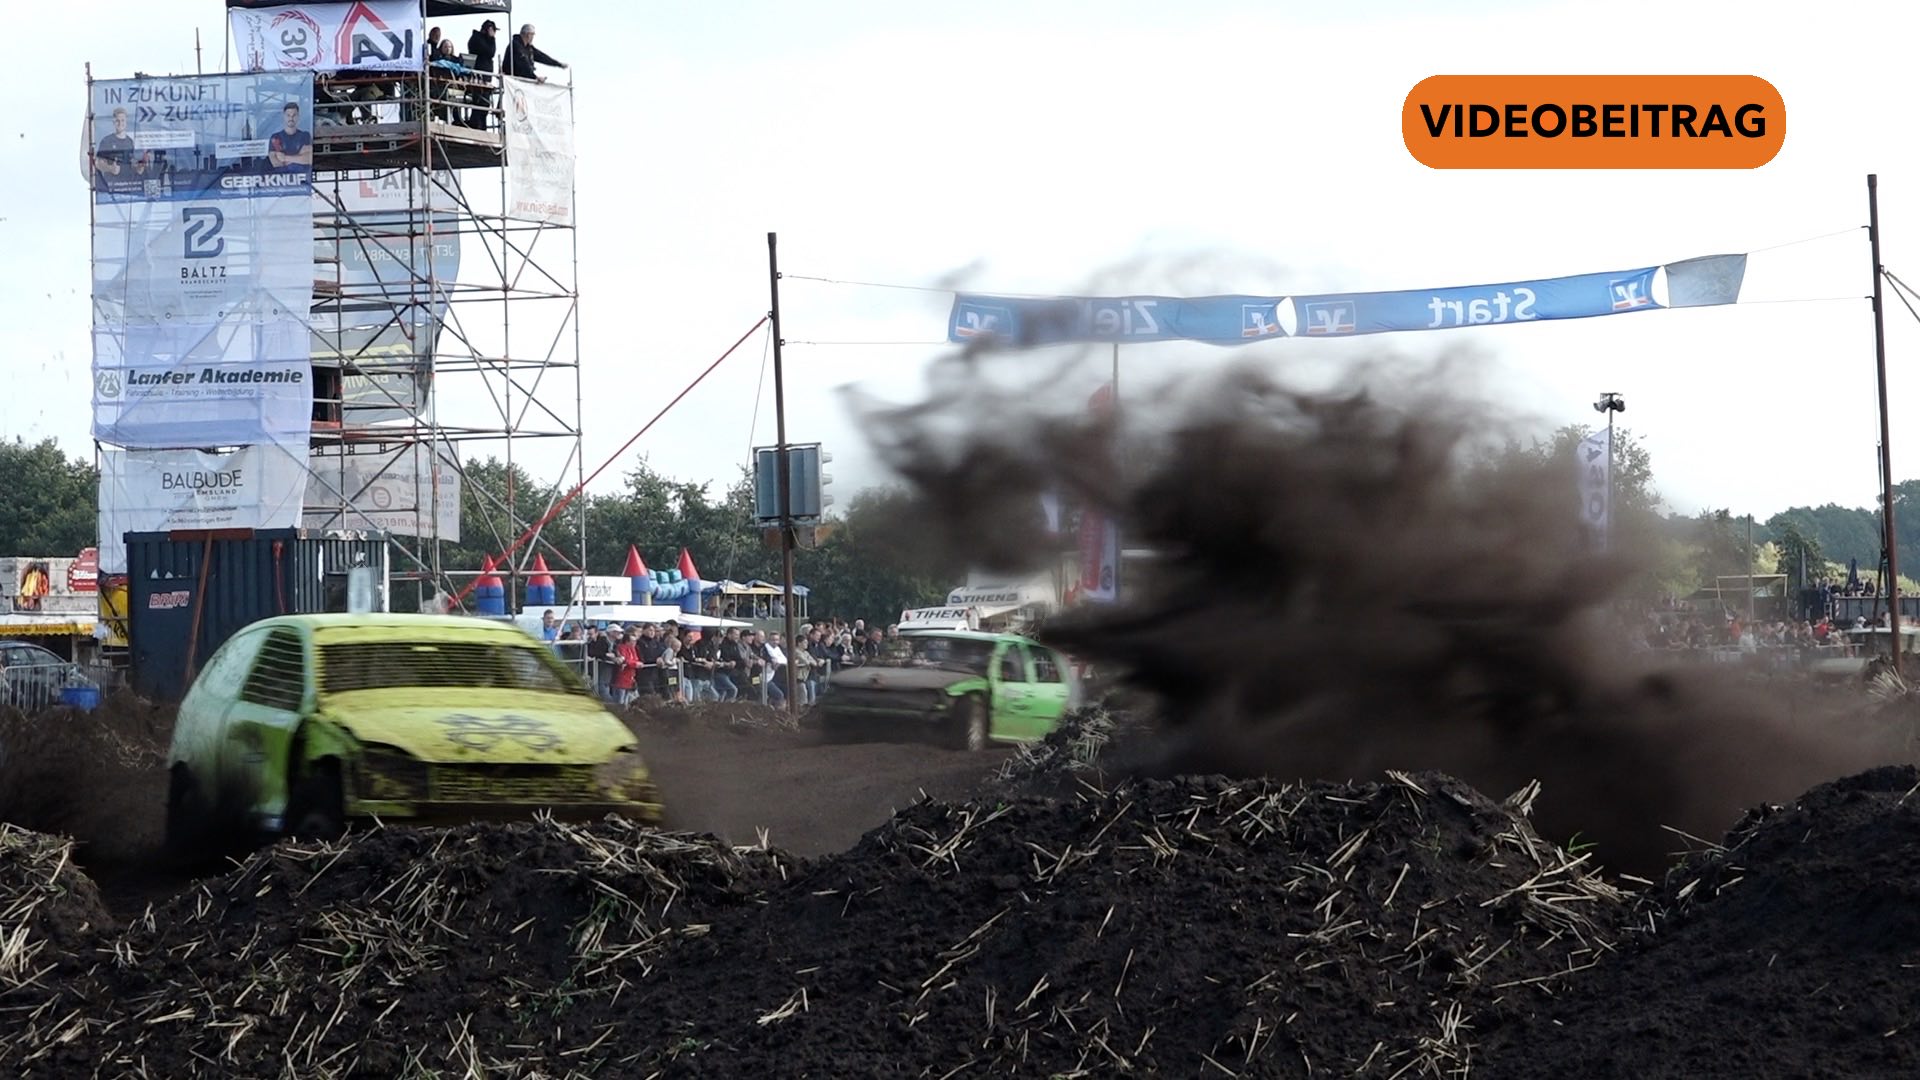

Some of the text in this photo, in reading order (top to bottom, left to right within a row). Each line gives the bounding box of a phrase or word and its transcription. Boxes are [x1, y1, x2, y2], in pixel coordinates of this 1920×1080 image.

[105, 83, 221, 104] IN ZUKUNFT
[181, 265, 227, 279] BALTZ
[127, 367, 303, 385] Lanfer Akademie
[915, 609, 966, 619] TIHEN
